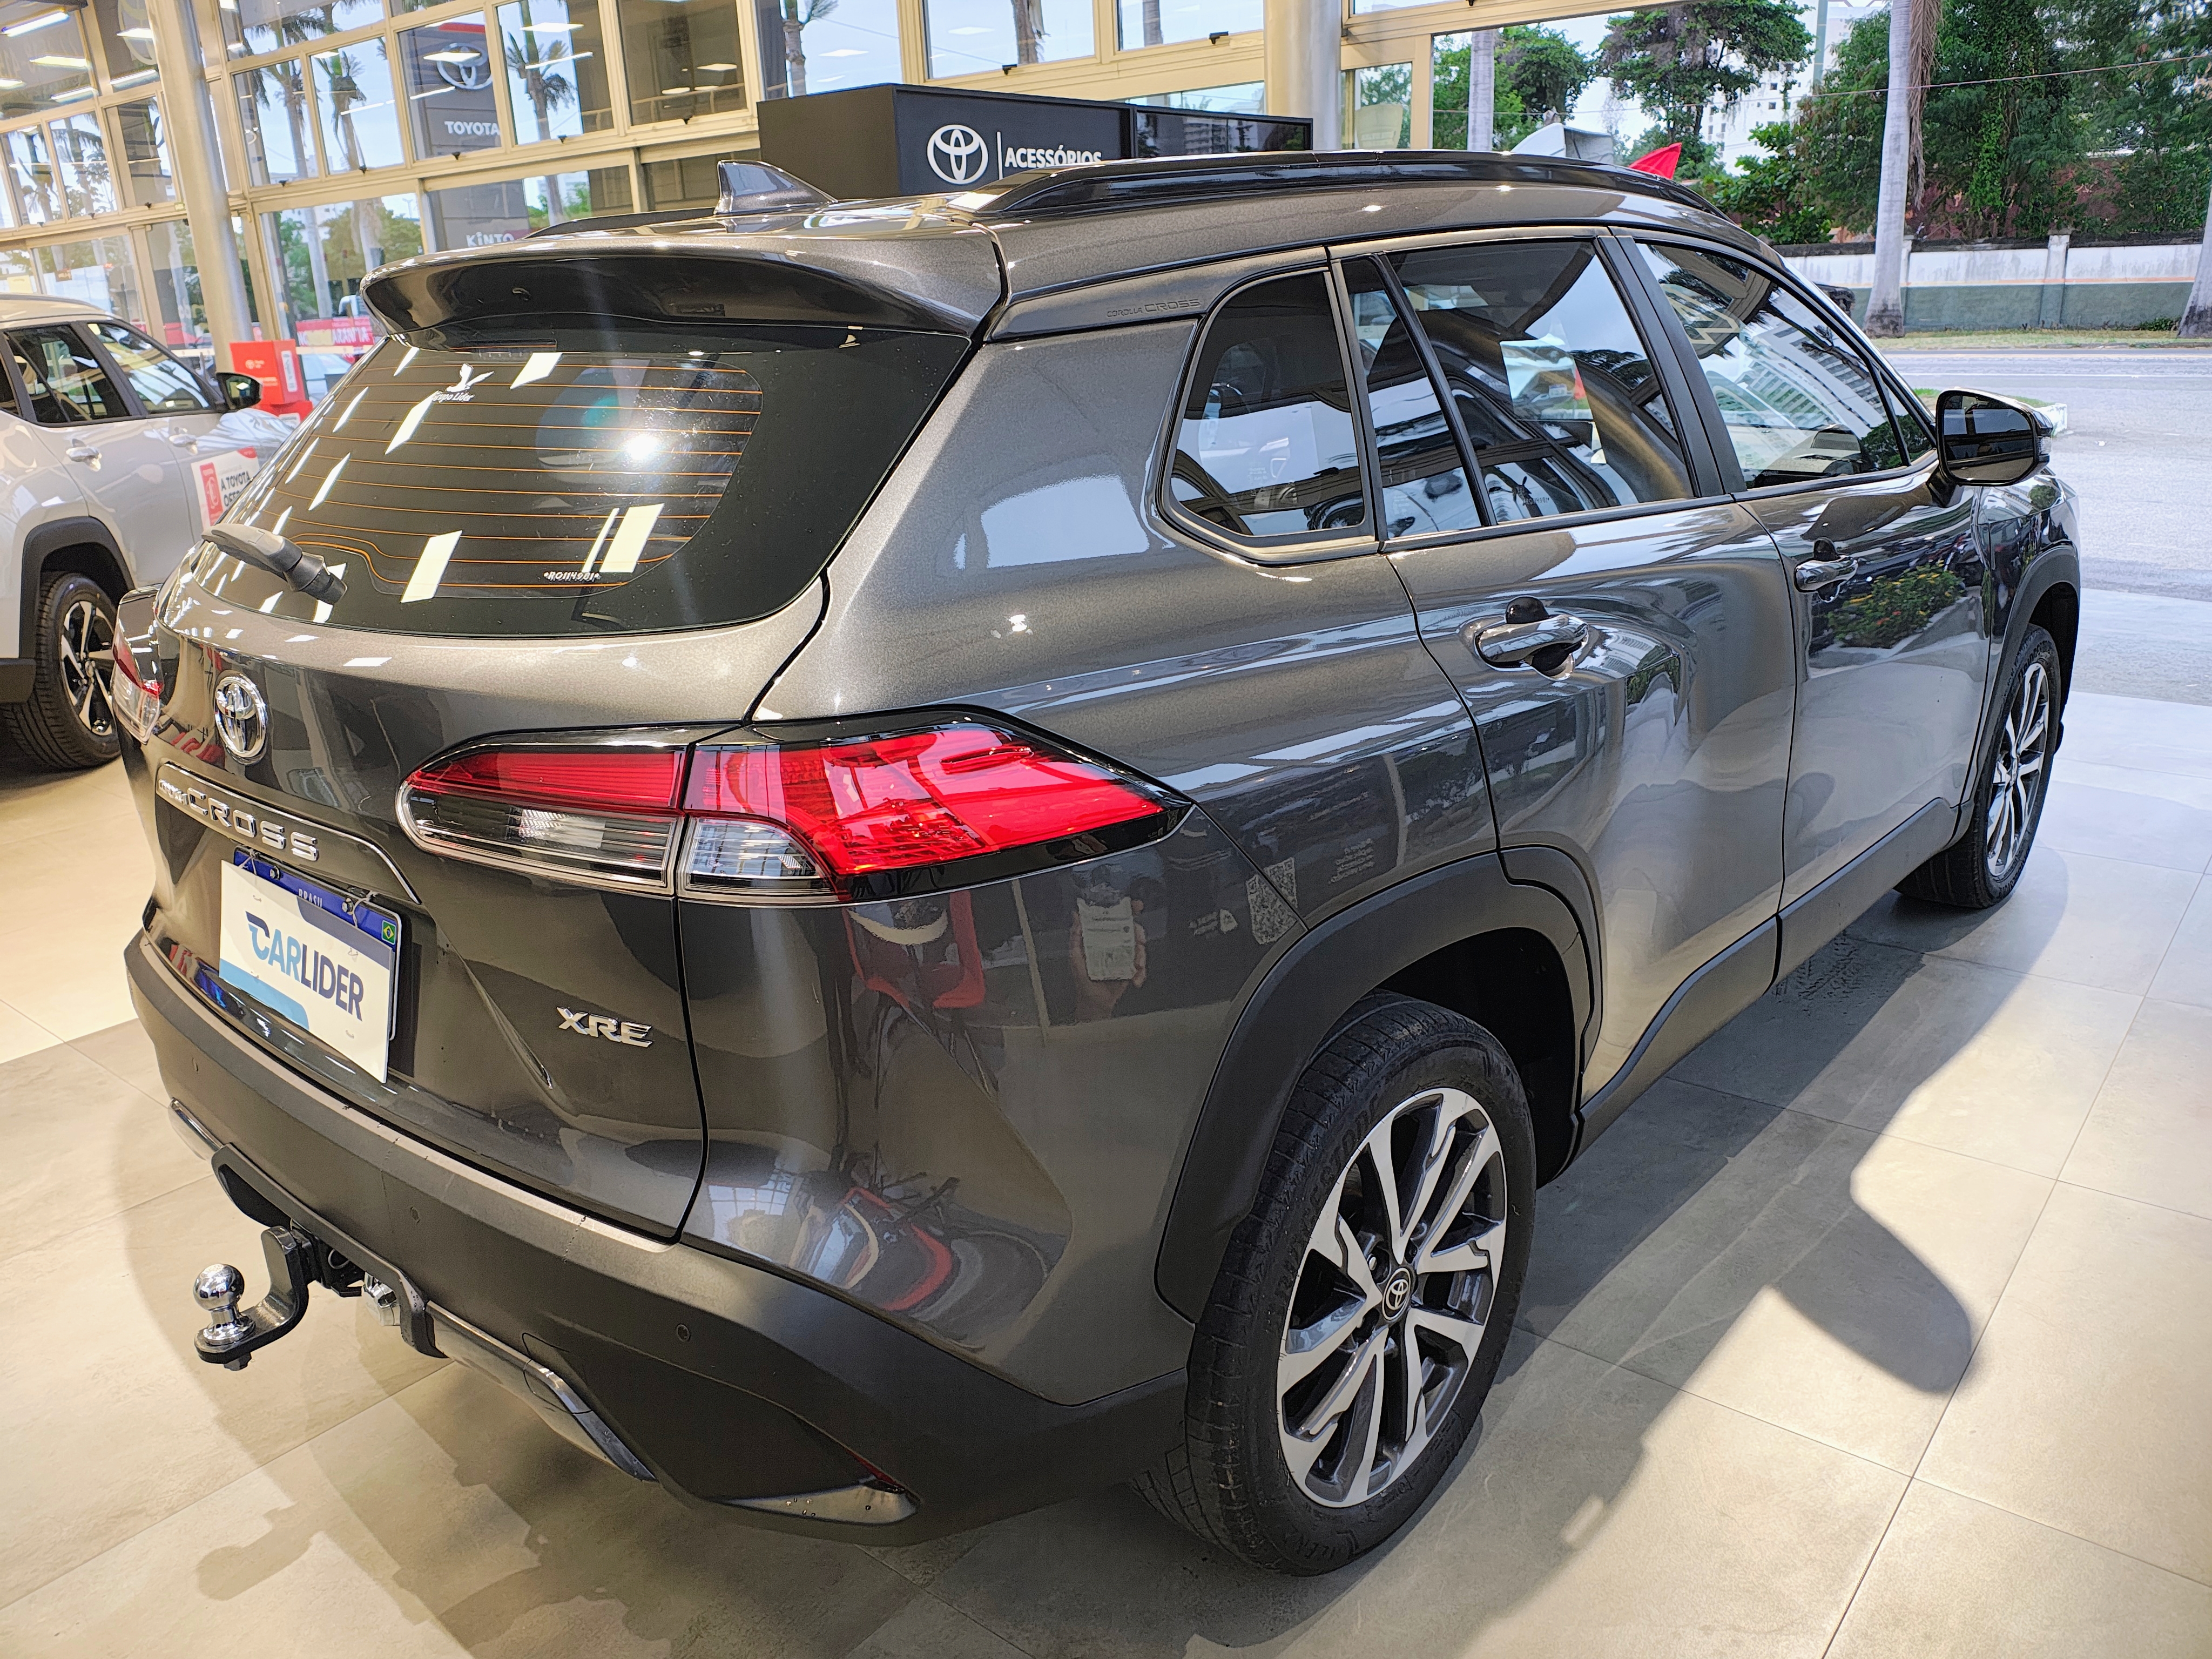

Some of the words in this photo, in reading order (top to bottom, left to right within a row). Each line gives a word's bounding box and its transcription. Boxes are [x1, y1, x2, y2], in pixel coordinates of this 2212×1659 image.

[444, 122, 500, 136] TOYOTA
[1004, 145, 1102, 168] ACESSÓRIOS
[1107, 307, 1143, 317] COROLLA
[1144, 299, 1201, 312] CROSS
[221, 478, 226, 491] A
[226, 471, 250, 489] TOYOTA
[187, 787, 320, 862] CROSS
[246, 911, 363, 1022] CARLIDER
[557, 1007, 653, 1048] XRE
